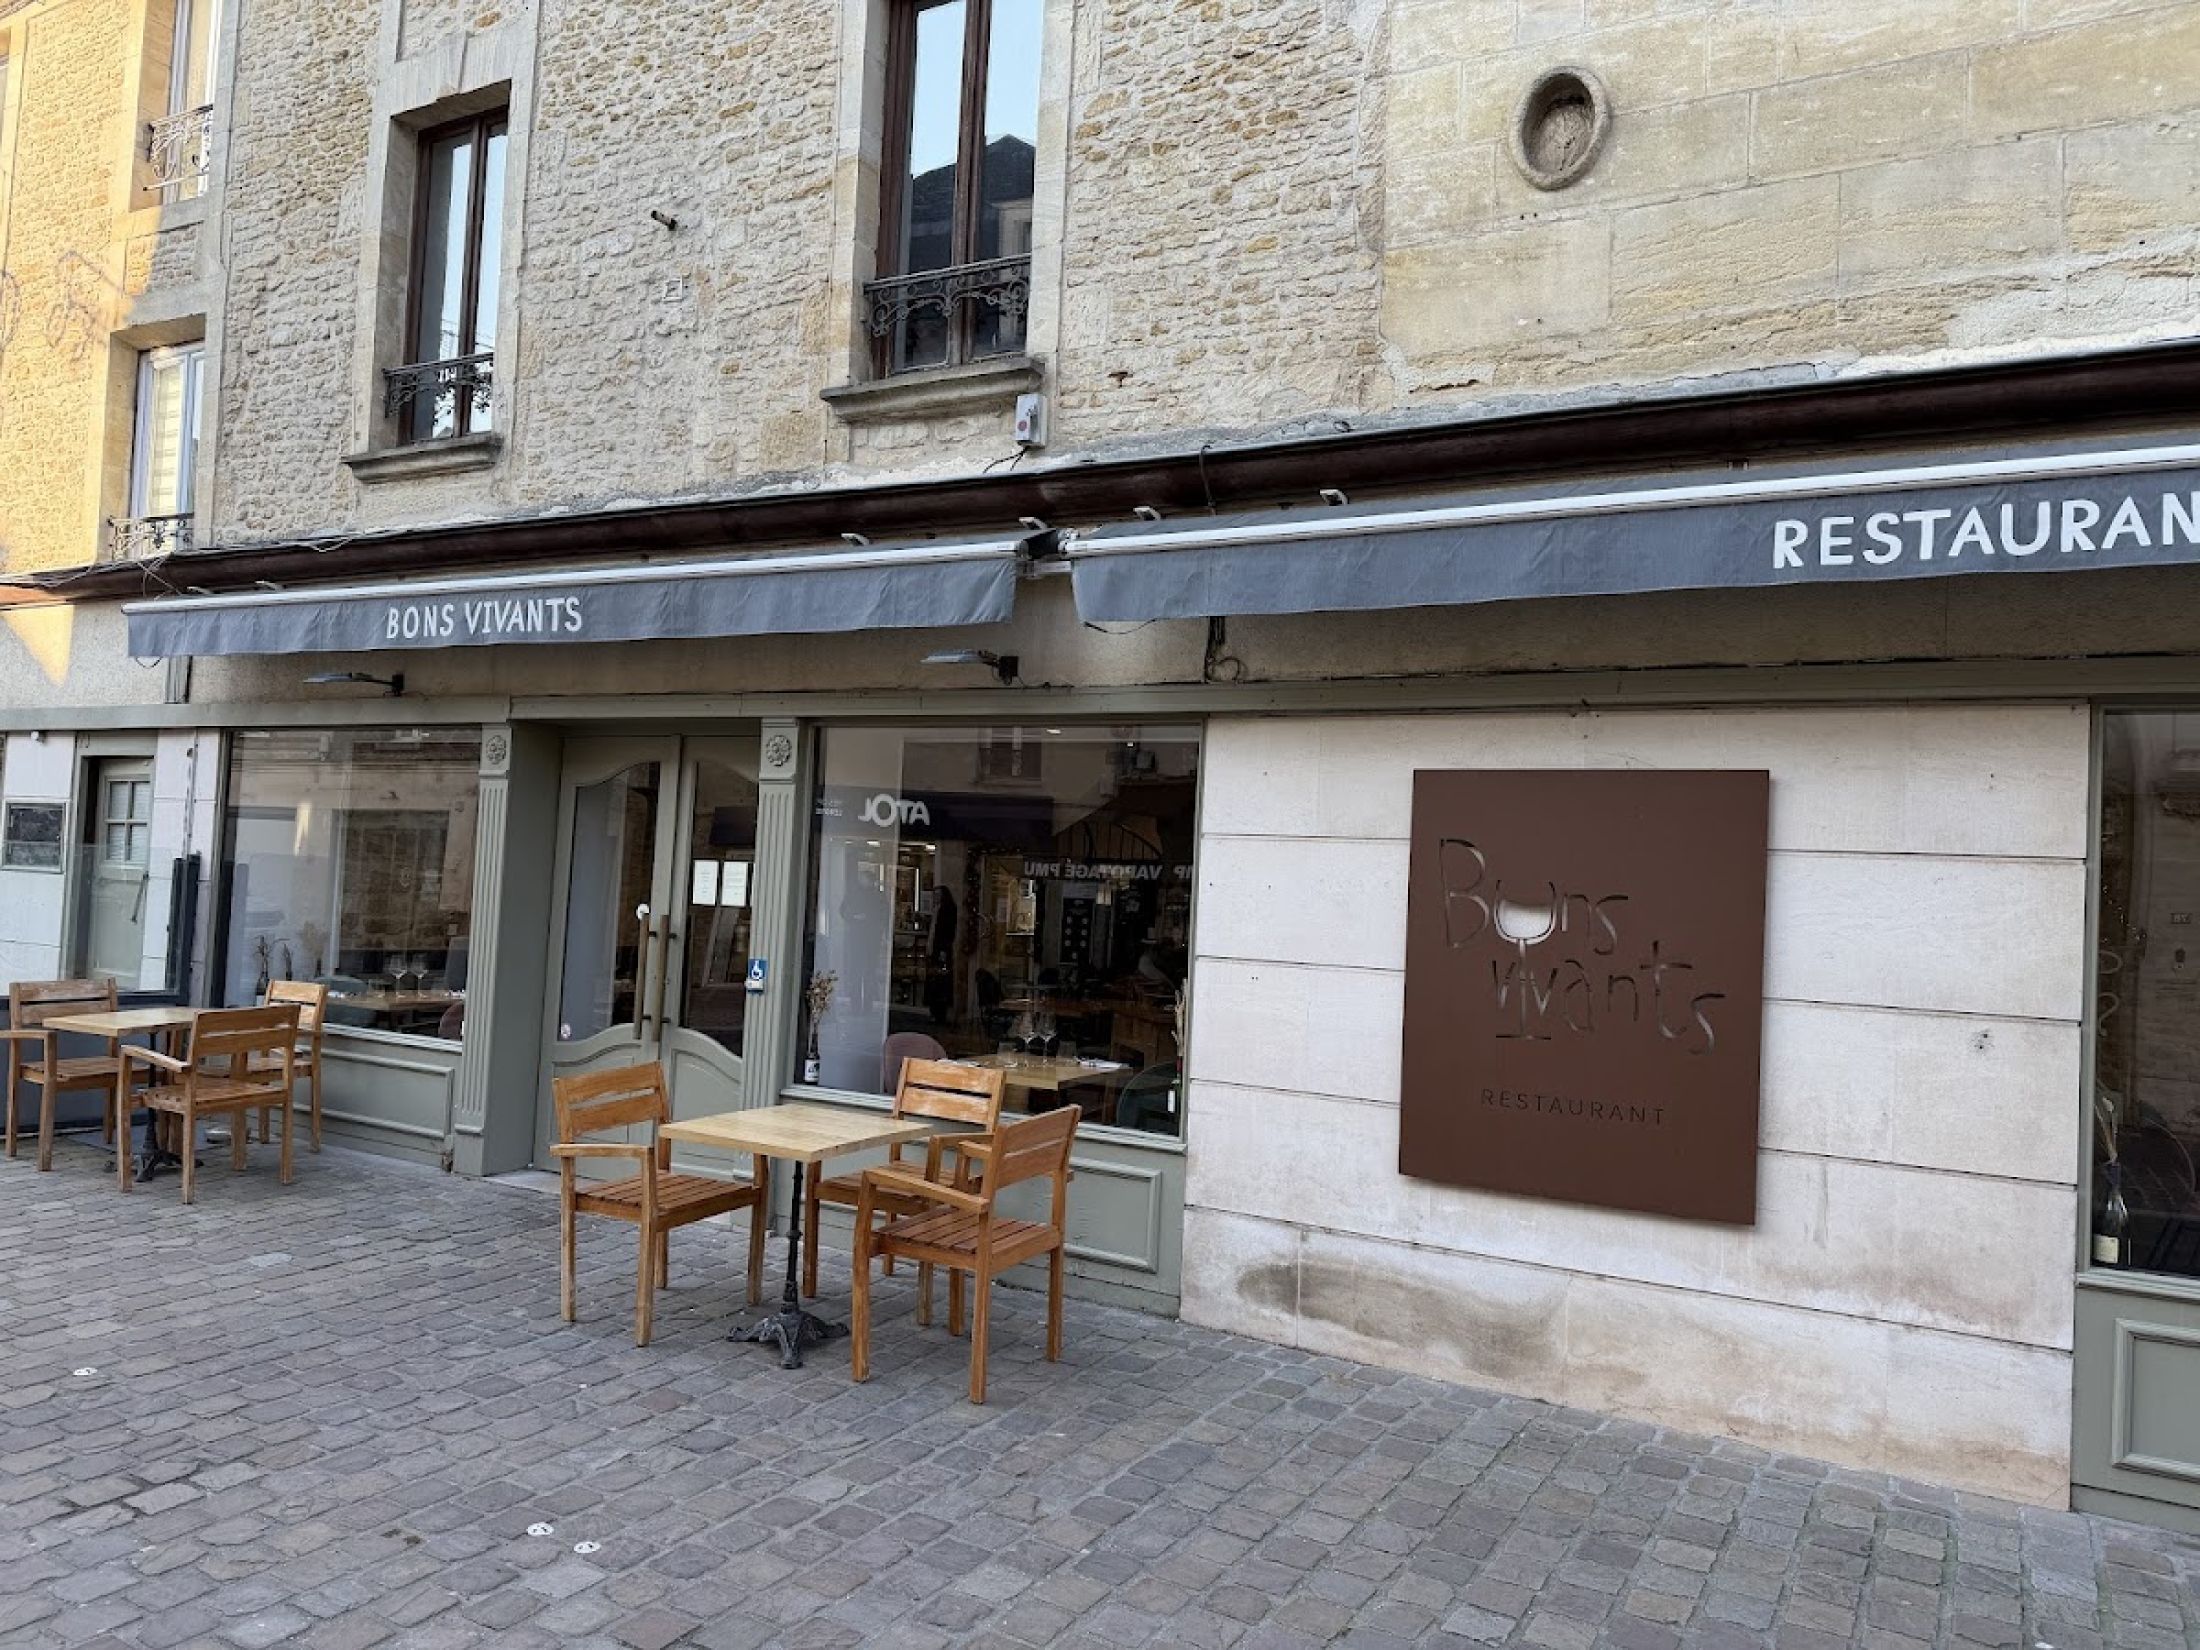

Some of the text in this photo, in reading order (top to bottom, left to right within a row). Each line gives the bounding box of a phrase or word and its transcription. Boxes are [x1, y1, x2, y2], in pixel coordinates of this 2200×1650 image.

[1773, 491, 2200, 569] RESTAURAN
[386, 596, 582, 639] BONS VIVANTS
[1481, 1088, 1665, 1126] RESTAURANT
